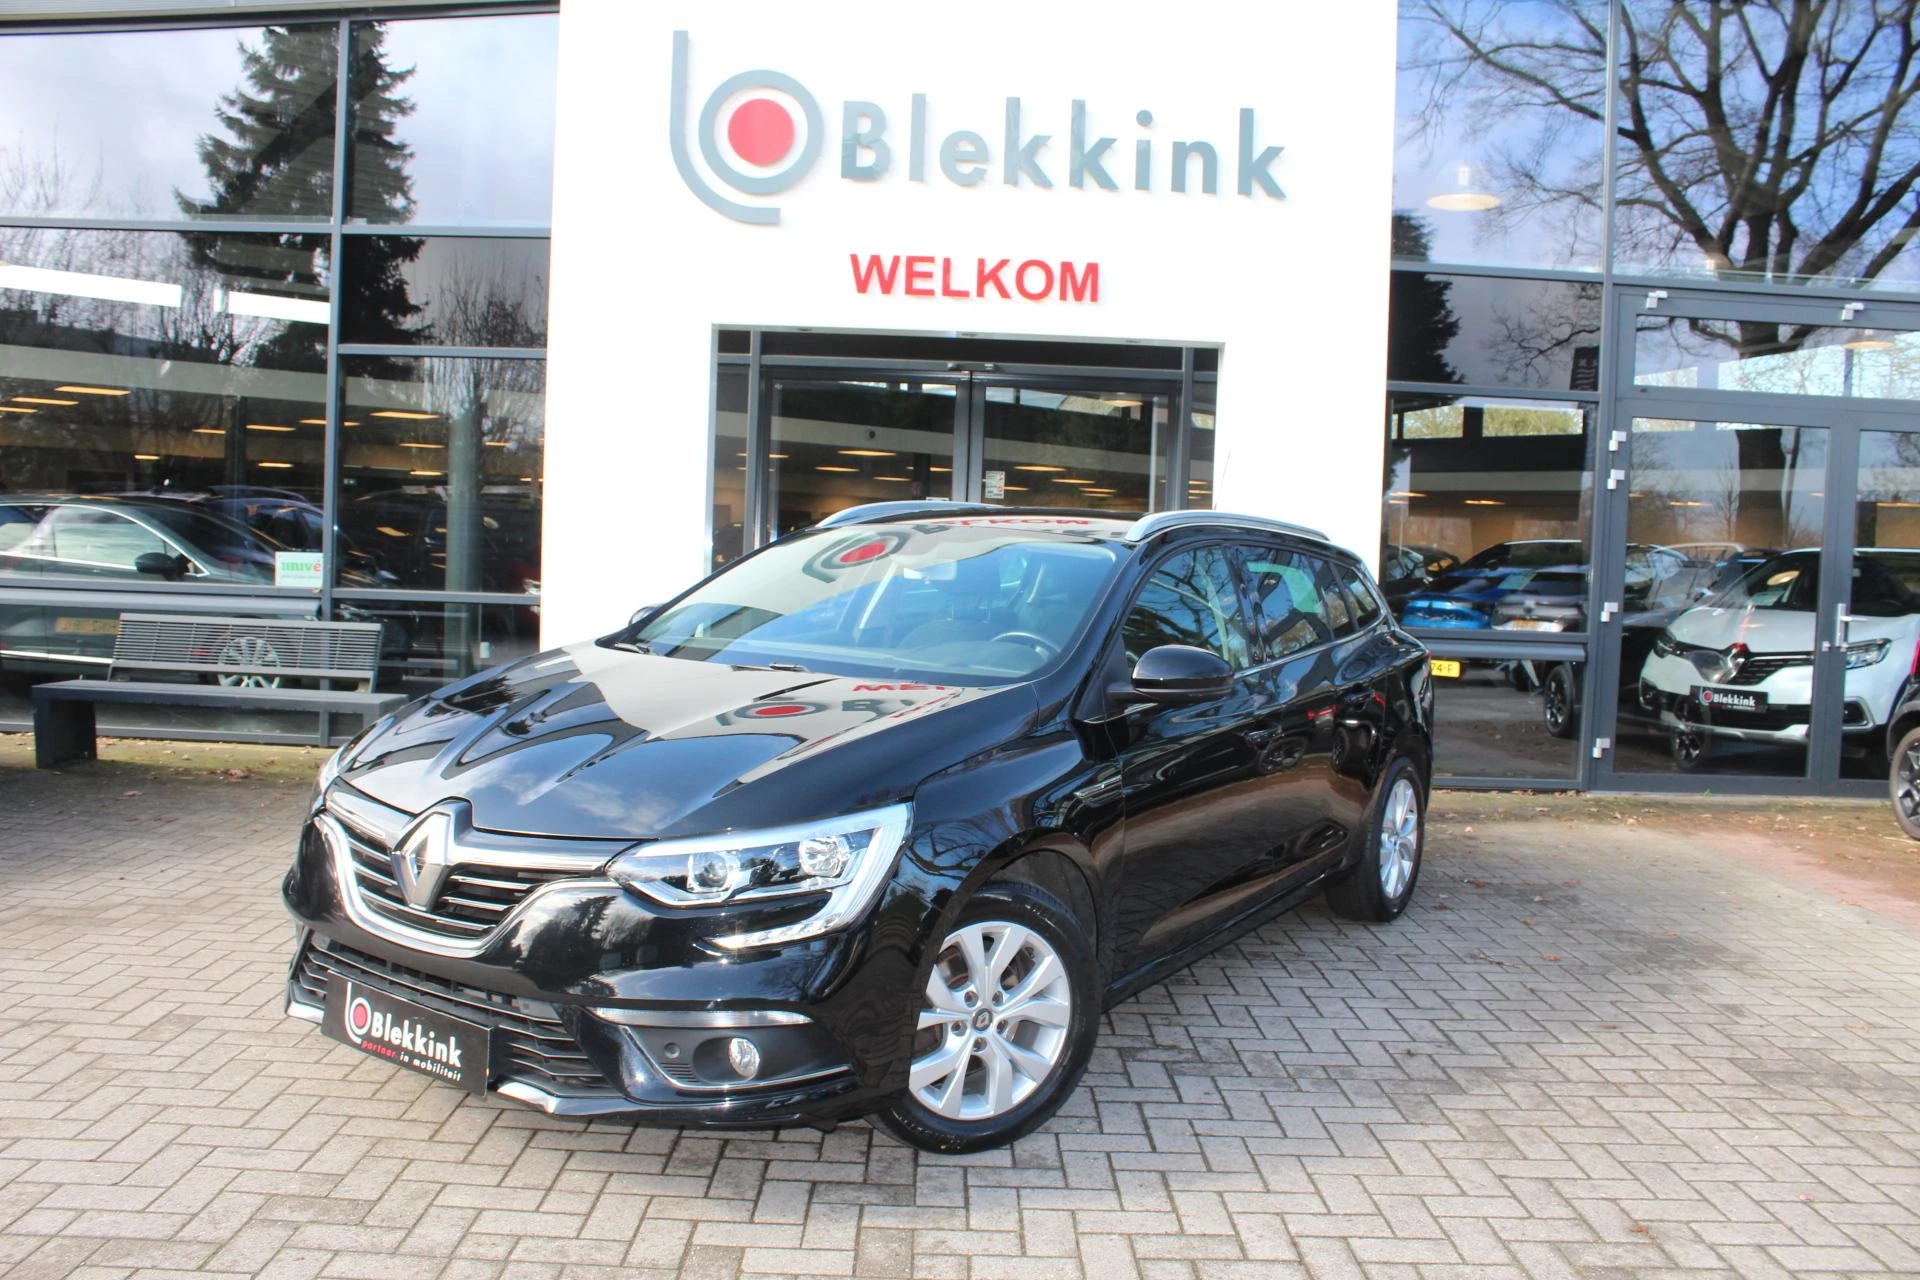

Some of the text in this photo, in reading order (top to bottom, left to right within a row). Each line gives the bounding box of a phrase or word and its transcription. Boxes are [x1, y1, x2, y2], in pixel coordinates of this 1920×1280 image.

[840, 93, 1287, 201] Blekkink
[850, 253, 1100, 303] WELKOM
[1713, 692, 1756, 707] Blekkink
[361, 1039, 461, 1082] partner in mobiliteit
[371, 1011, 462, 1068] Blekkink
